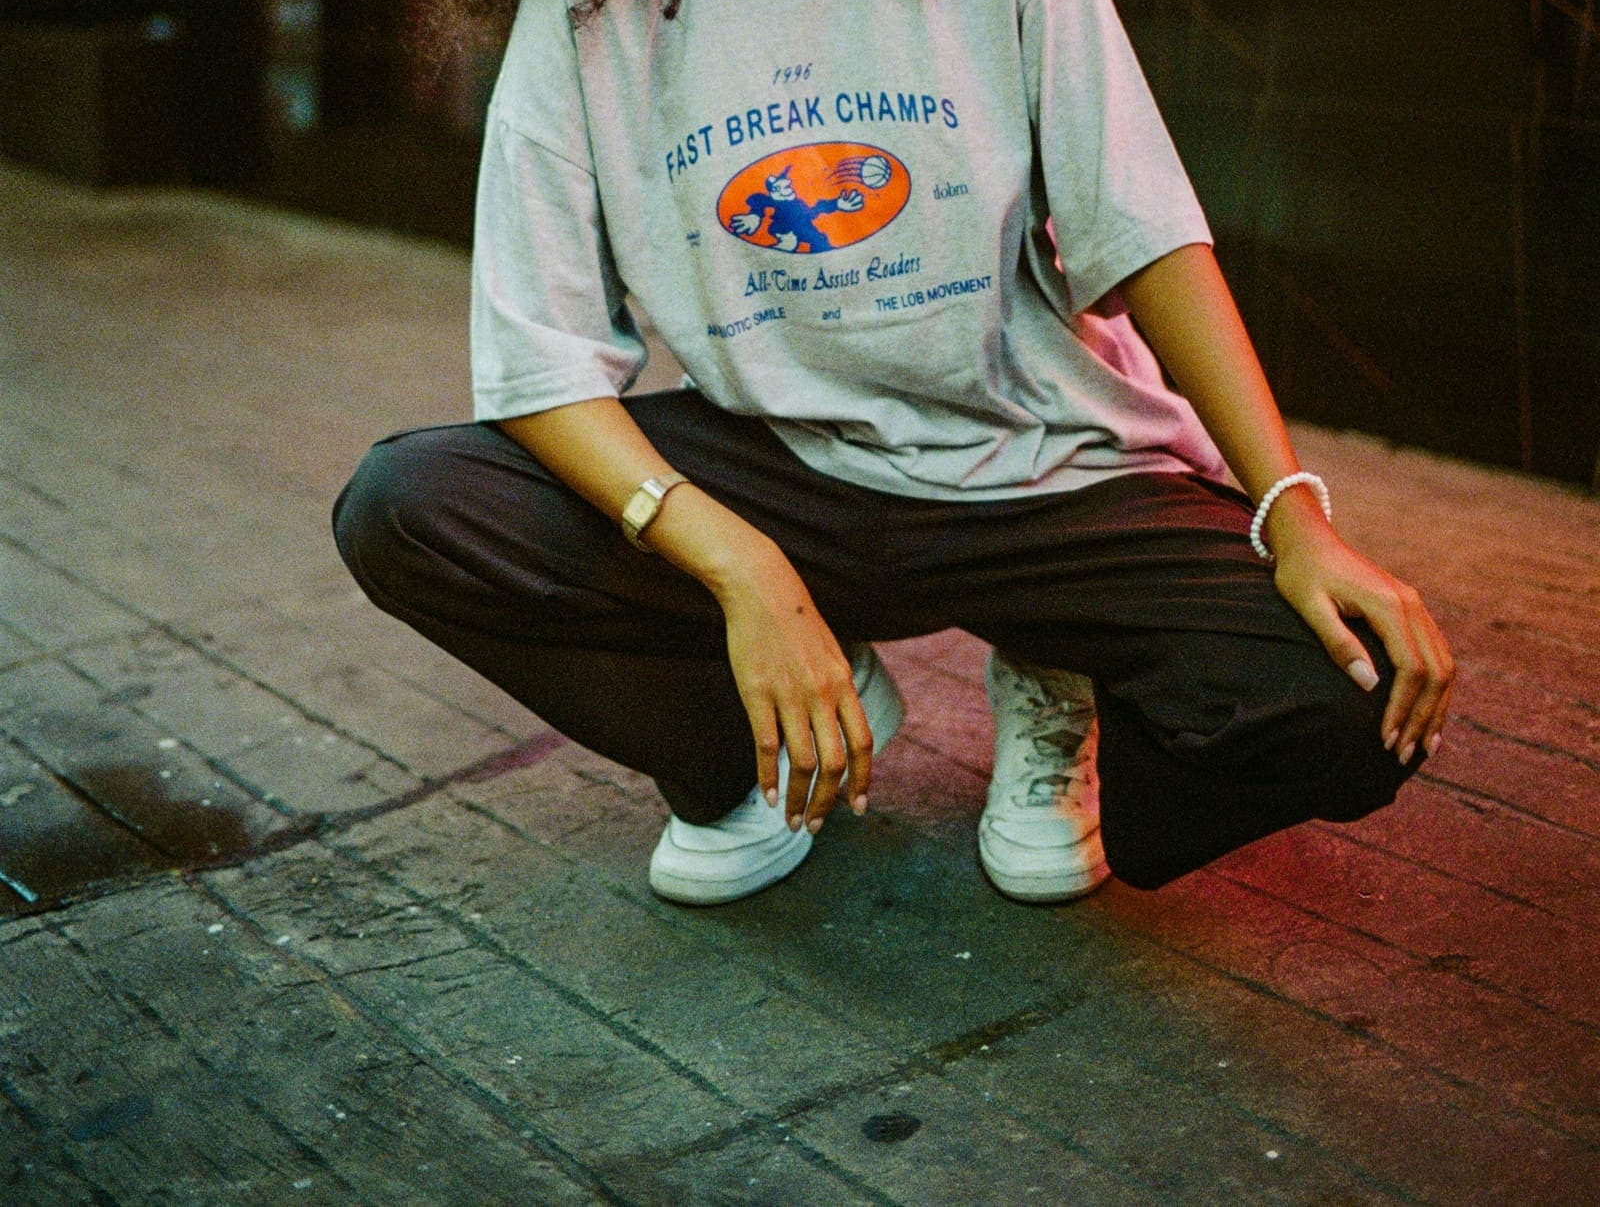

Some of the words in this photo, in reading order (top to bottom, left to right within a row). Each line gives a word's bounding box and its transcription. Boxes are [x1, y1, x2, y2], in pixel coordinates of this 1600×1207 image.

[772, 62, 813, 86] 1996
[666, 125, 713, 184] FAST
[726, 96, 825, 146] BREAK
[835, 91, 959, 129] CHAMPS
[744, 269, 808, 296] All-Time
[812, 267, 861, 290] Assists
[866, 253, 921, 282] Leaders
[752, 306, 787, 325] SMILE
[822, 307, 841, 321] and
[875, 296, 899, 311] THE
[901, 292, 925, 308] LOB
[927, 275, 992, 302] MOVEMENT
